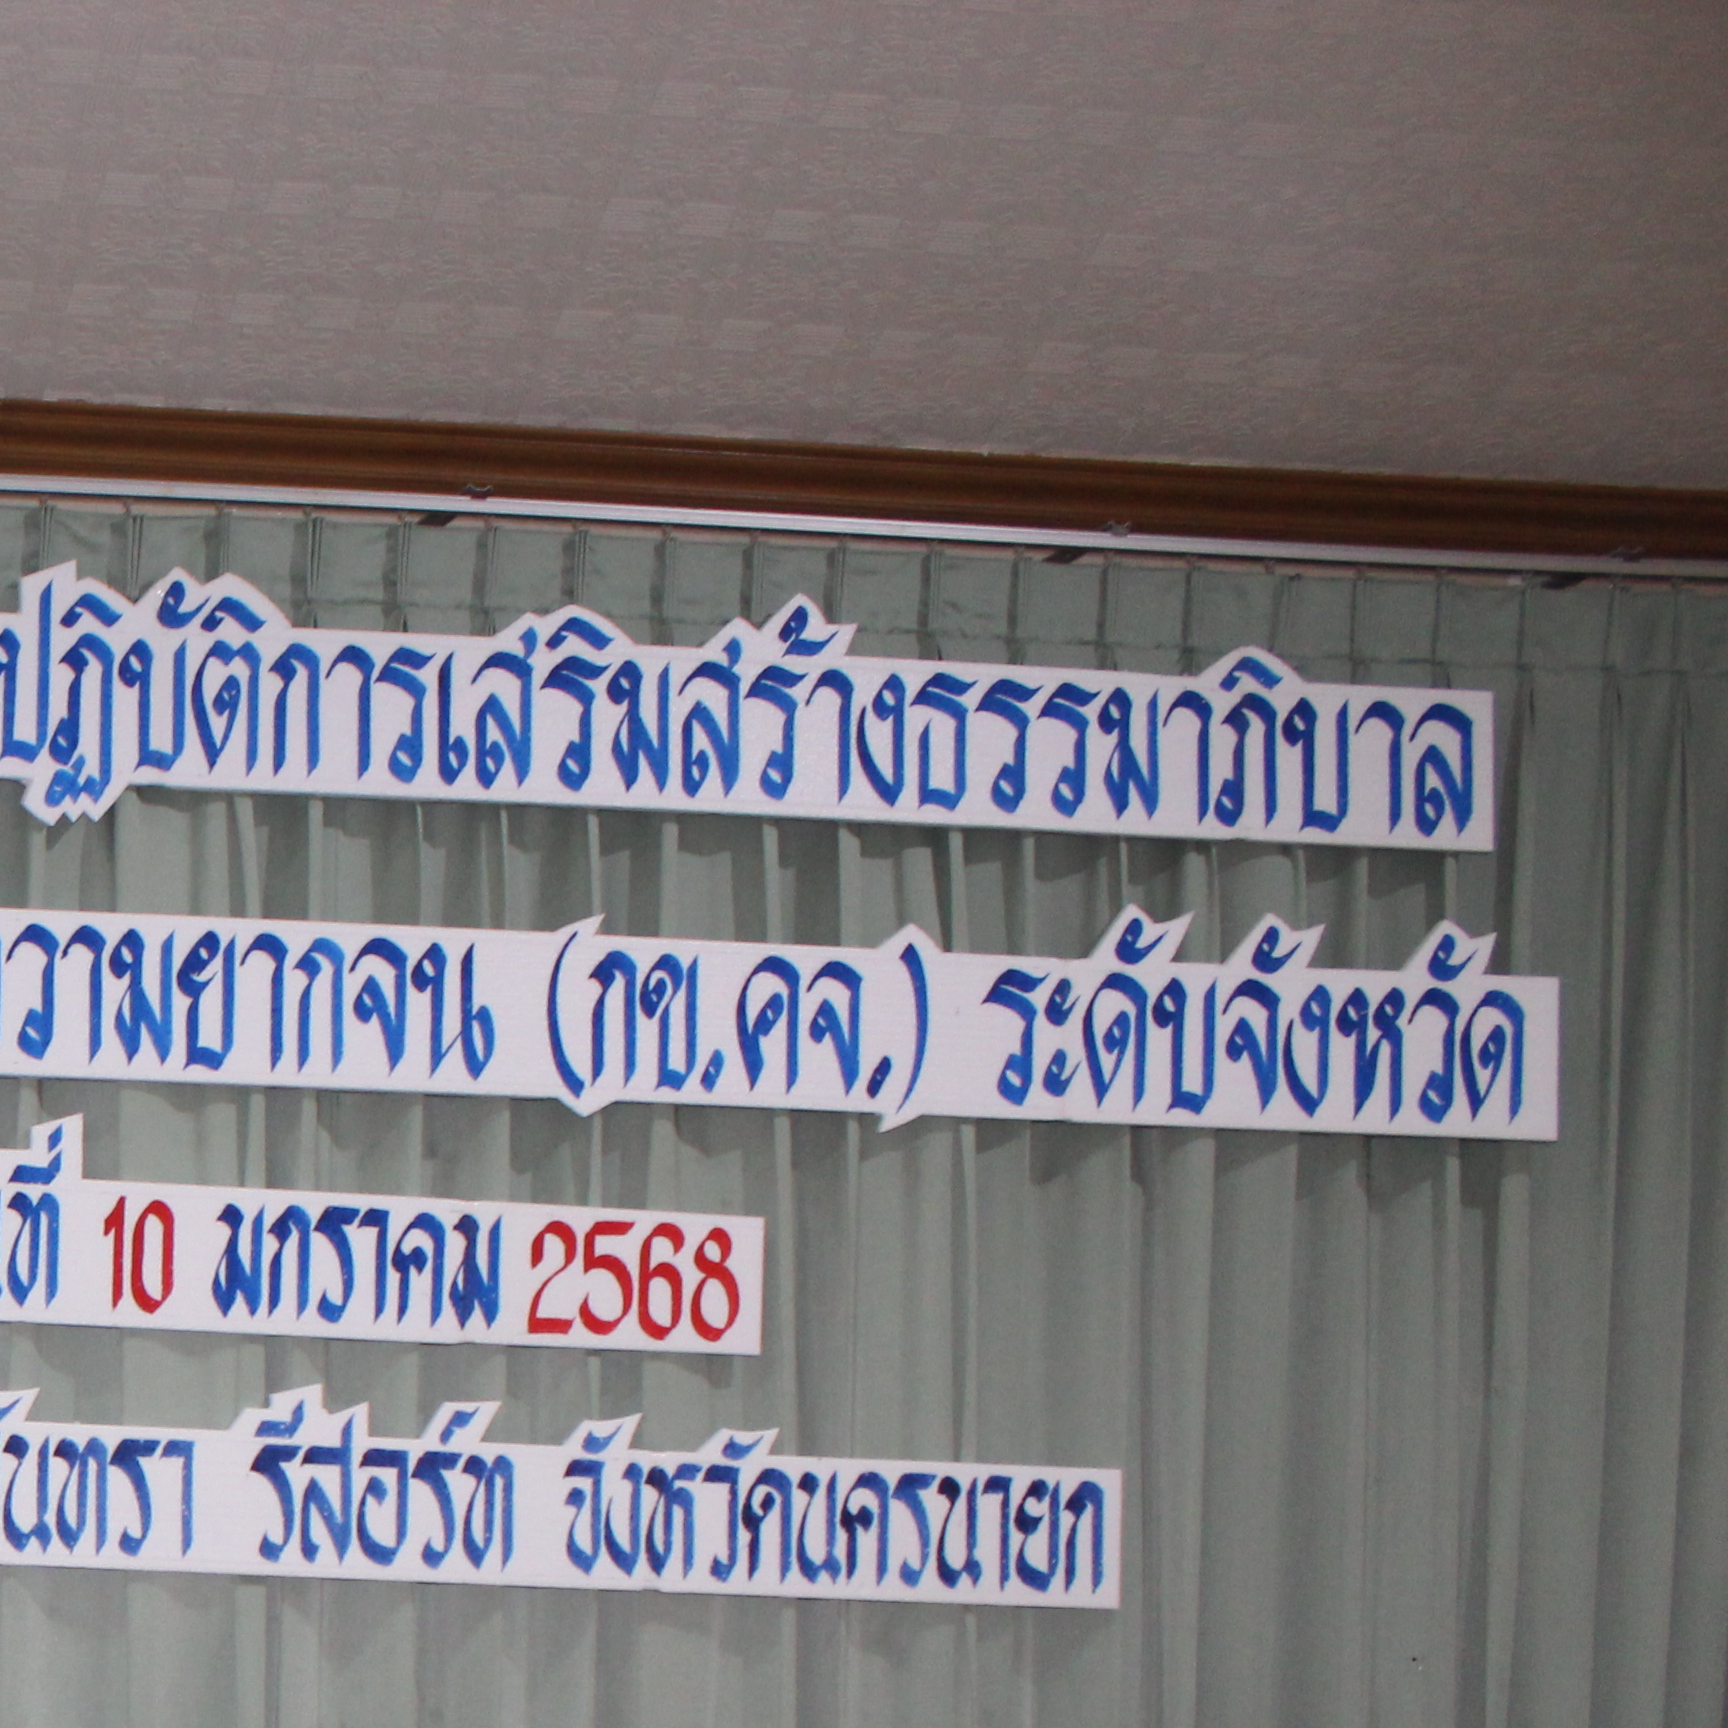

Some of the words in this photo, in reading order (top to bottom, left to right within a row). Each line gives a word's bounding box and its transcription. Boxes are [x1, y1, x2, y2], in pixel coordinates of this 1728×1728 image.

[548, 932, 931, 1112] (กข.คจ.)
[980, 916, 1526, 1124] ระดับจังหวัด
[103, 1195, 175, 1315] 10
[212, 1202, 502, 1330] มกราคม
[527, 1220, 739, 1342] 2568
[250, 1400, 516, 1572] รีสอร์ท
[565, 1430, 1106, 1594] จังหวัดนครนายก
